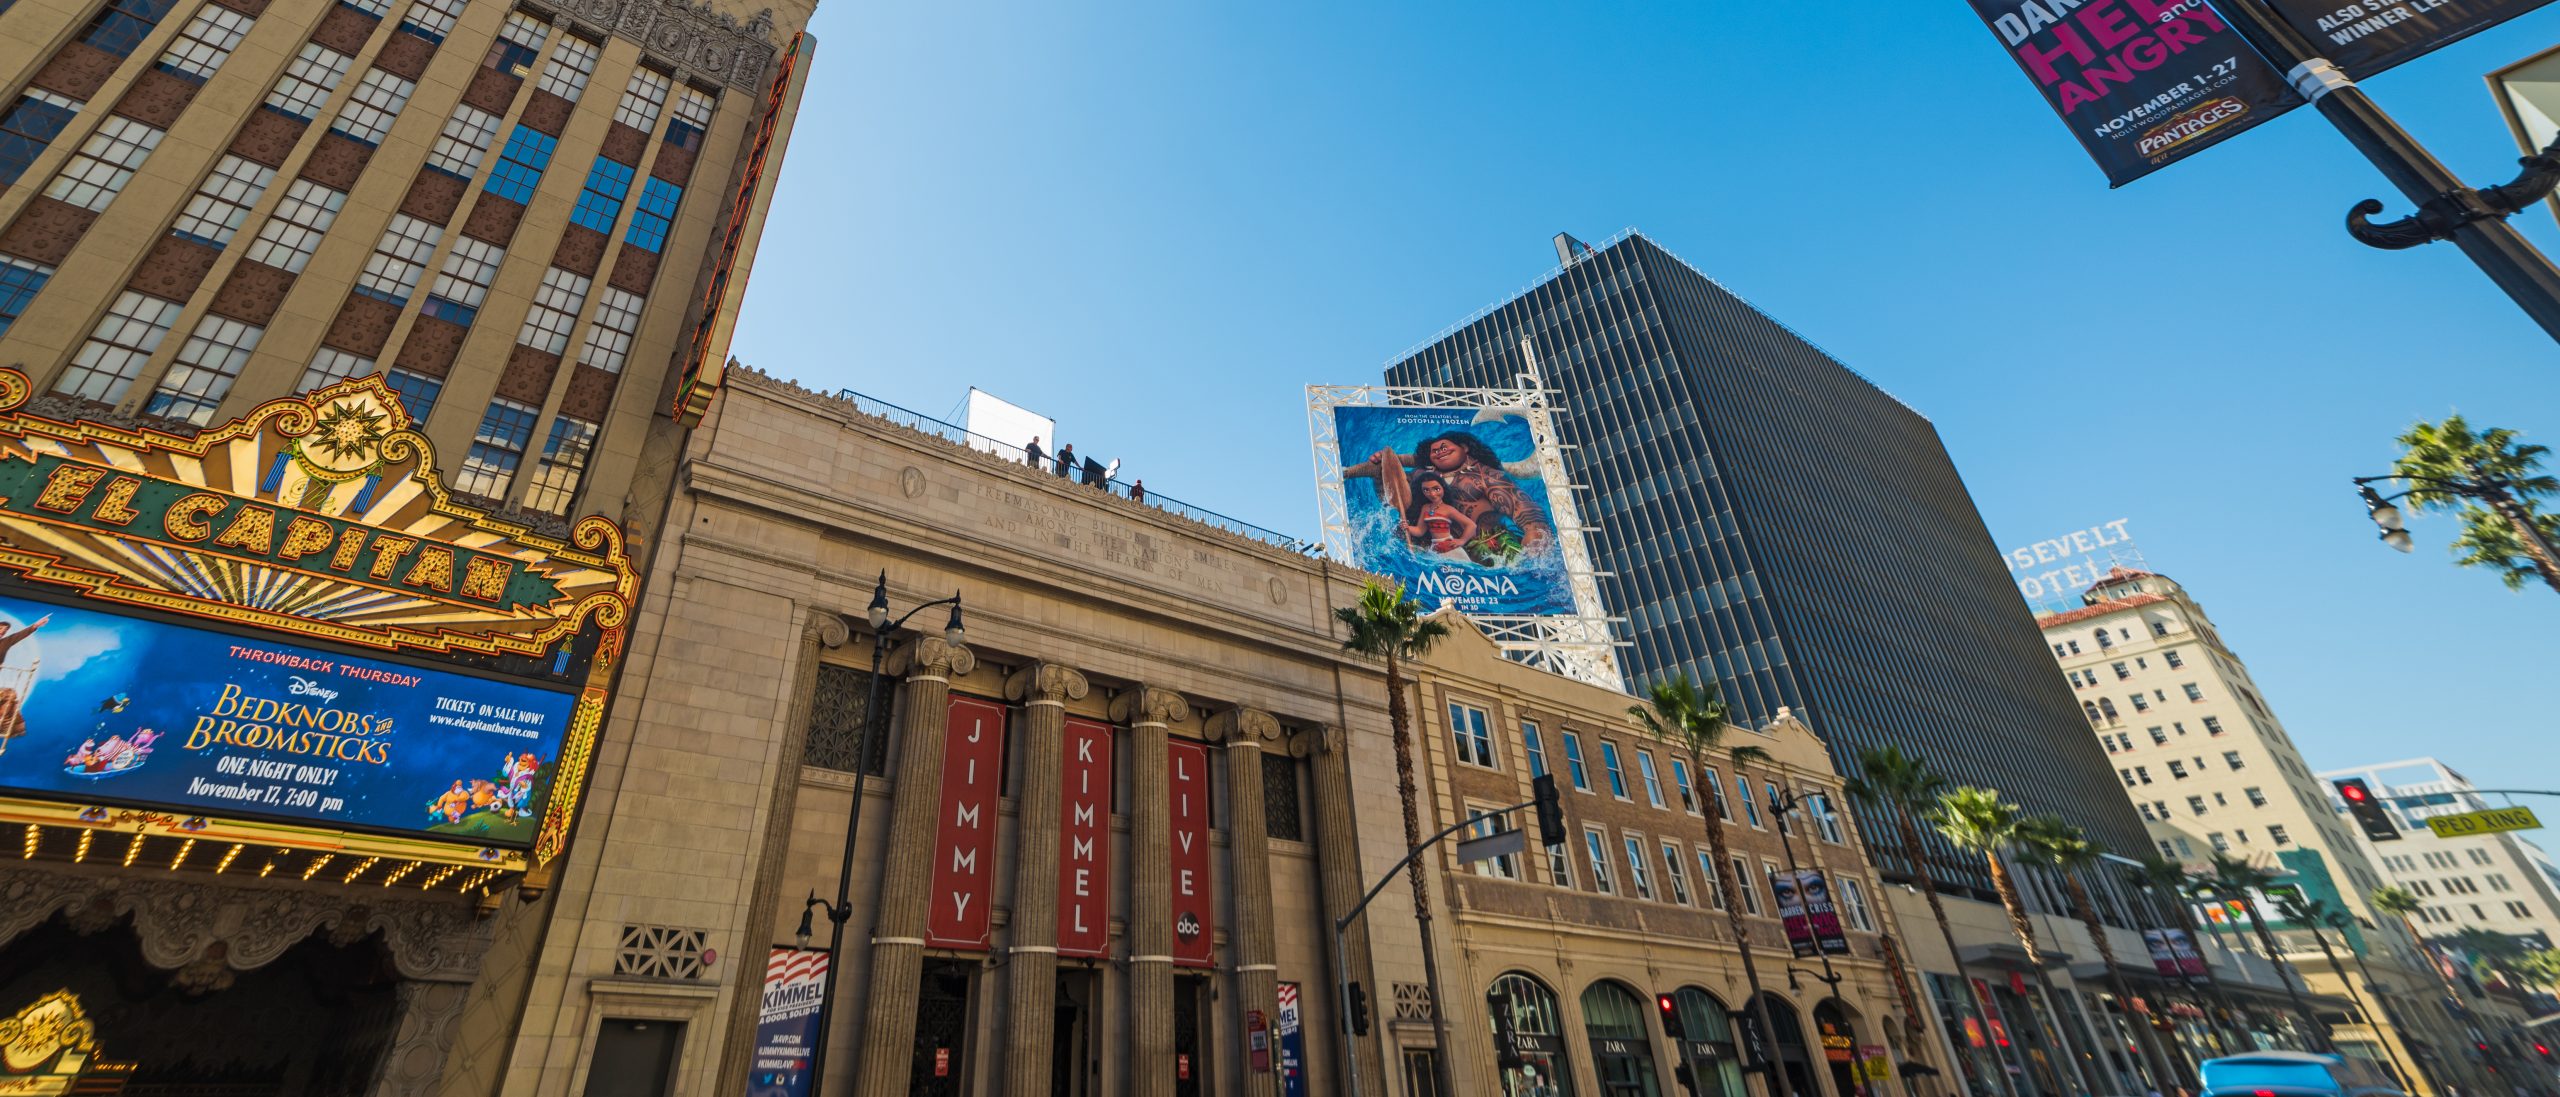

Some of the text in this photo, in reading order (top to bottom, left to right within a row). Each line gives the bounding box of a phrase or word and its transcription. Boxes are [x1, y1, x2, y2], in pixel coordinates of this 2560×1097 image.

[2316, 4, 2365, 32] ALSO
[2329, 6, 2414, 46] WINNER
[2059, 3, 2226, 116] ANGRY
[2094, 82, 2193, 137] NOVEMBER
[2112, 74, 2237, 140] HOLLYWOODPANTAGES.COM
[2139, 100, 2243, 155] PANTAGES
[34, 463, 513, 603] EL CAPITAN
[976, 484, 1079, 523] FREEMASONRY
[1092, 520, 1141, 544] BUILDS
[1153, 539, 1173, 552] ITS
[985, 516, 1224, 593] AND IN THE HEARTS OF MEN
[1026, 513, 1190, 570] AMONG THE NATIONS
[1415, 570, 1519, 596] MOANA
[229, 645, 422, 688] THROWBACK THURSDAY
[211, 683, 394, 736] BEDKNOBS AND
[429, 714, 539, 740] www.elcapitantheatre.com
[435, 696, 544, 725] TICKETS ON SALE NOW!
[183, 715, 391, 765] BROOMSTICKS
[216, 756, 339, 786] ONE NIGHT ONLY!
[187, 777, 344, 812] November 17, 7:00 pm
[953, 719, 981, 922] JIMMY
[1073, 737, 1094, 933] KIMMEL
[1178, 757, 1194, 896] LIVE
[2434, 811, 2530, 833] PED XING
[1177, 917, 1200, 935] abc
[1808, 902, 1834, 913] CRISS
[759, 1017, 764, 1025] A
[788, 1007, 811, 1018] SOLID
[762, 983, 822, 1009] KIMMEL
[1502, 1003, 1519, 1057] ZARA
[1516, 1036, 1540, 1049] ZARA
[1605, 1040, 1627, 1053] ZARA
[1695, 1043, 1717, 1055] ZARA
